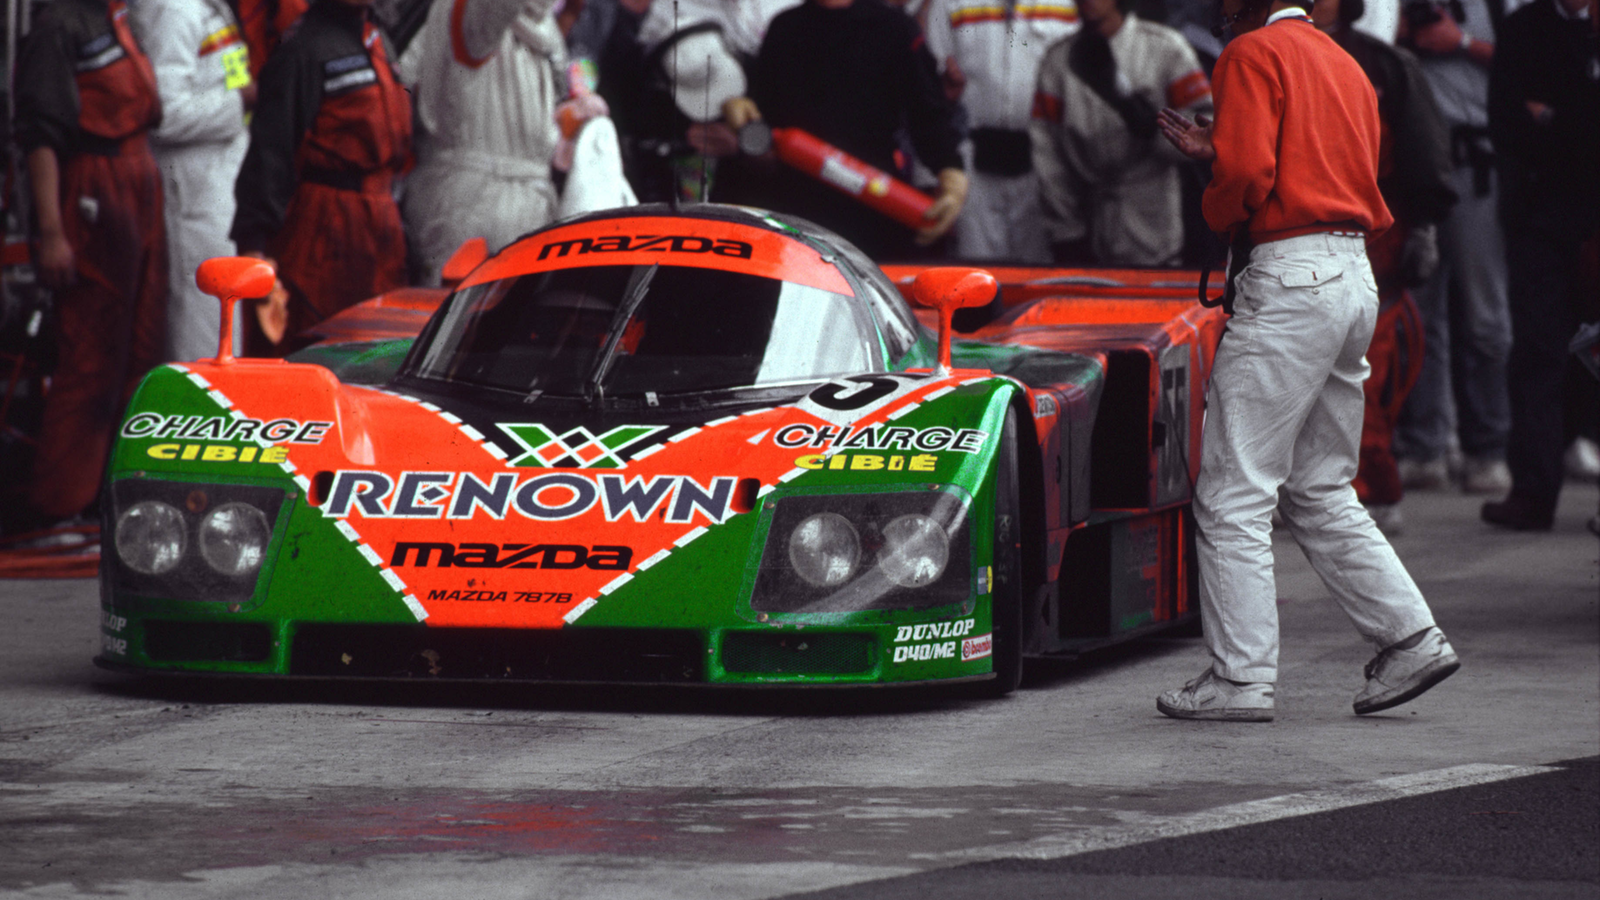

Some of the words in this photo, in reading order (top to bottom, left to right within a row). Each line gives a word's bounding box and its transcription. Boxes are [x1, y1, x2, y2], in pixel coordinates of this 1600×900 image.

[536, 235, 753, 261] mazda
[121, 412, 334, 444] CHARGE
[774, 424, 989, 455] CHARGE
[321, 470, 738, 524] RENOWN
[390, 541, 633, 570] mazda
[427, 590, 508, 602] MAZDA
[513, 591, 573, 604] 787B
[893, 618, 975, 642] DUNLOP
[893, 641, 956, 663] D40/M2
